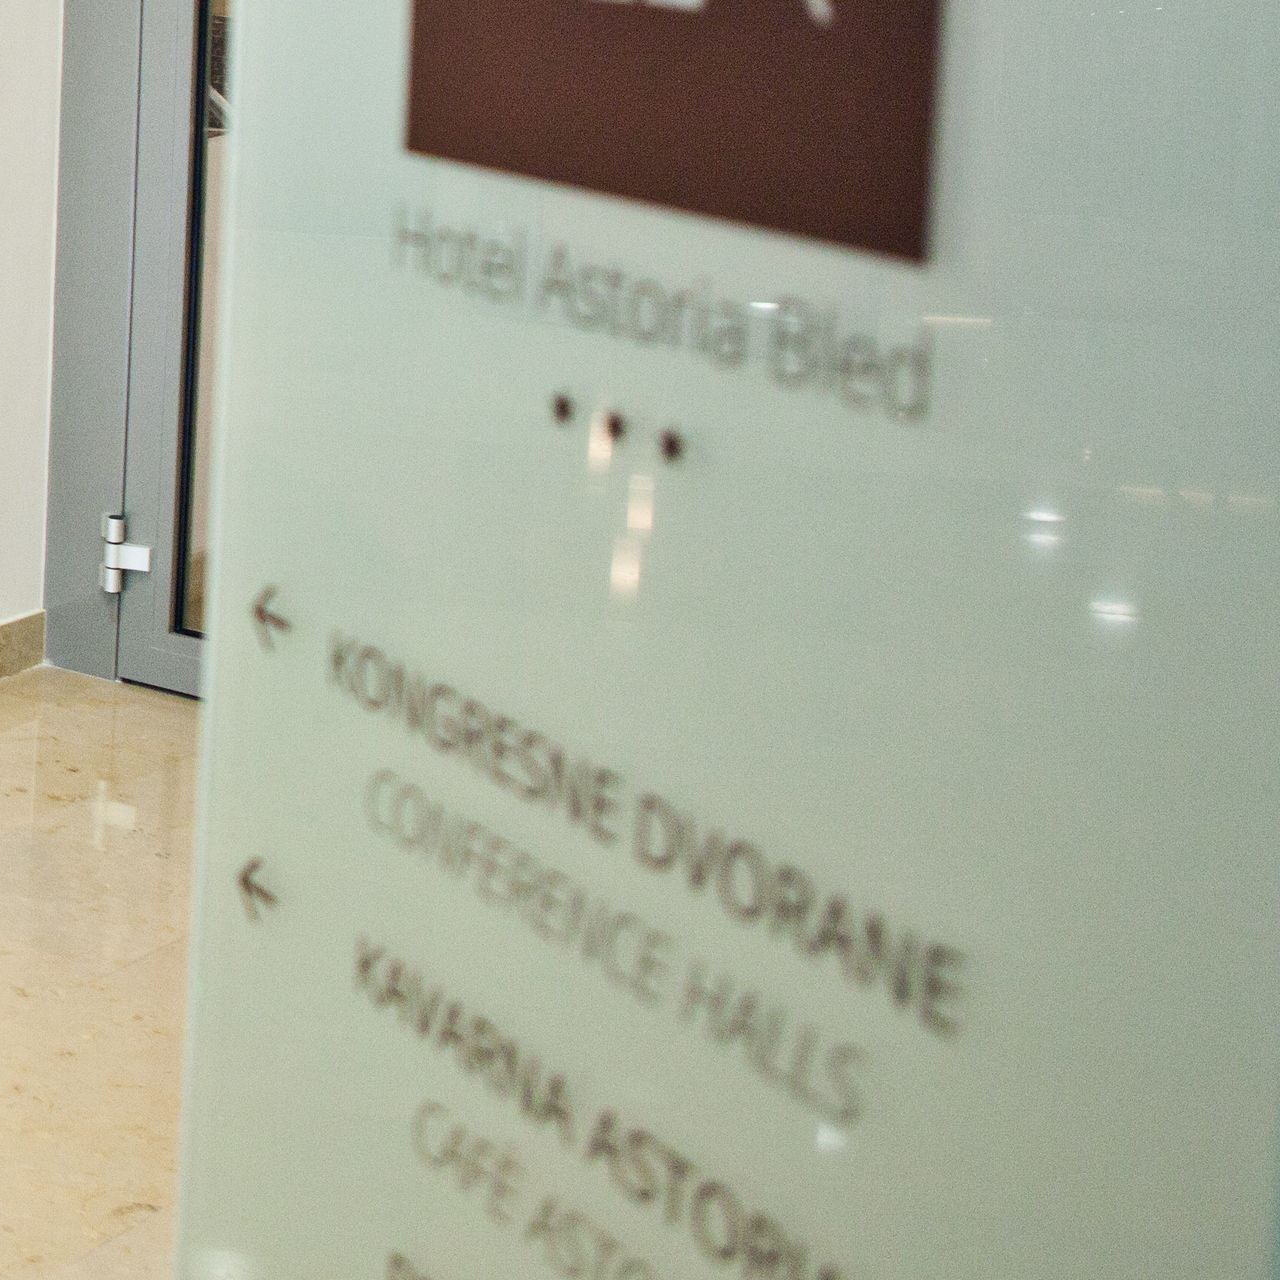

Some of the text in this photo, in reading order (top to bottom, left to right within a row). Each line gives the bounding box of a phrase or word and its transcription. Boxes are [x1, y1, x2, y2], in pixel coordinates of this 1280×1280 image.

[390, 206, 934, 422] Hotel Astoria Bled
[326, 628, 970, 1042] KONGRESNE DVORANE
[363, 766, 868, 1125] CONFERENCE HALLS
[352, 932, 840, 1280] KAVARNA ASTORI
